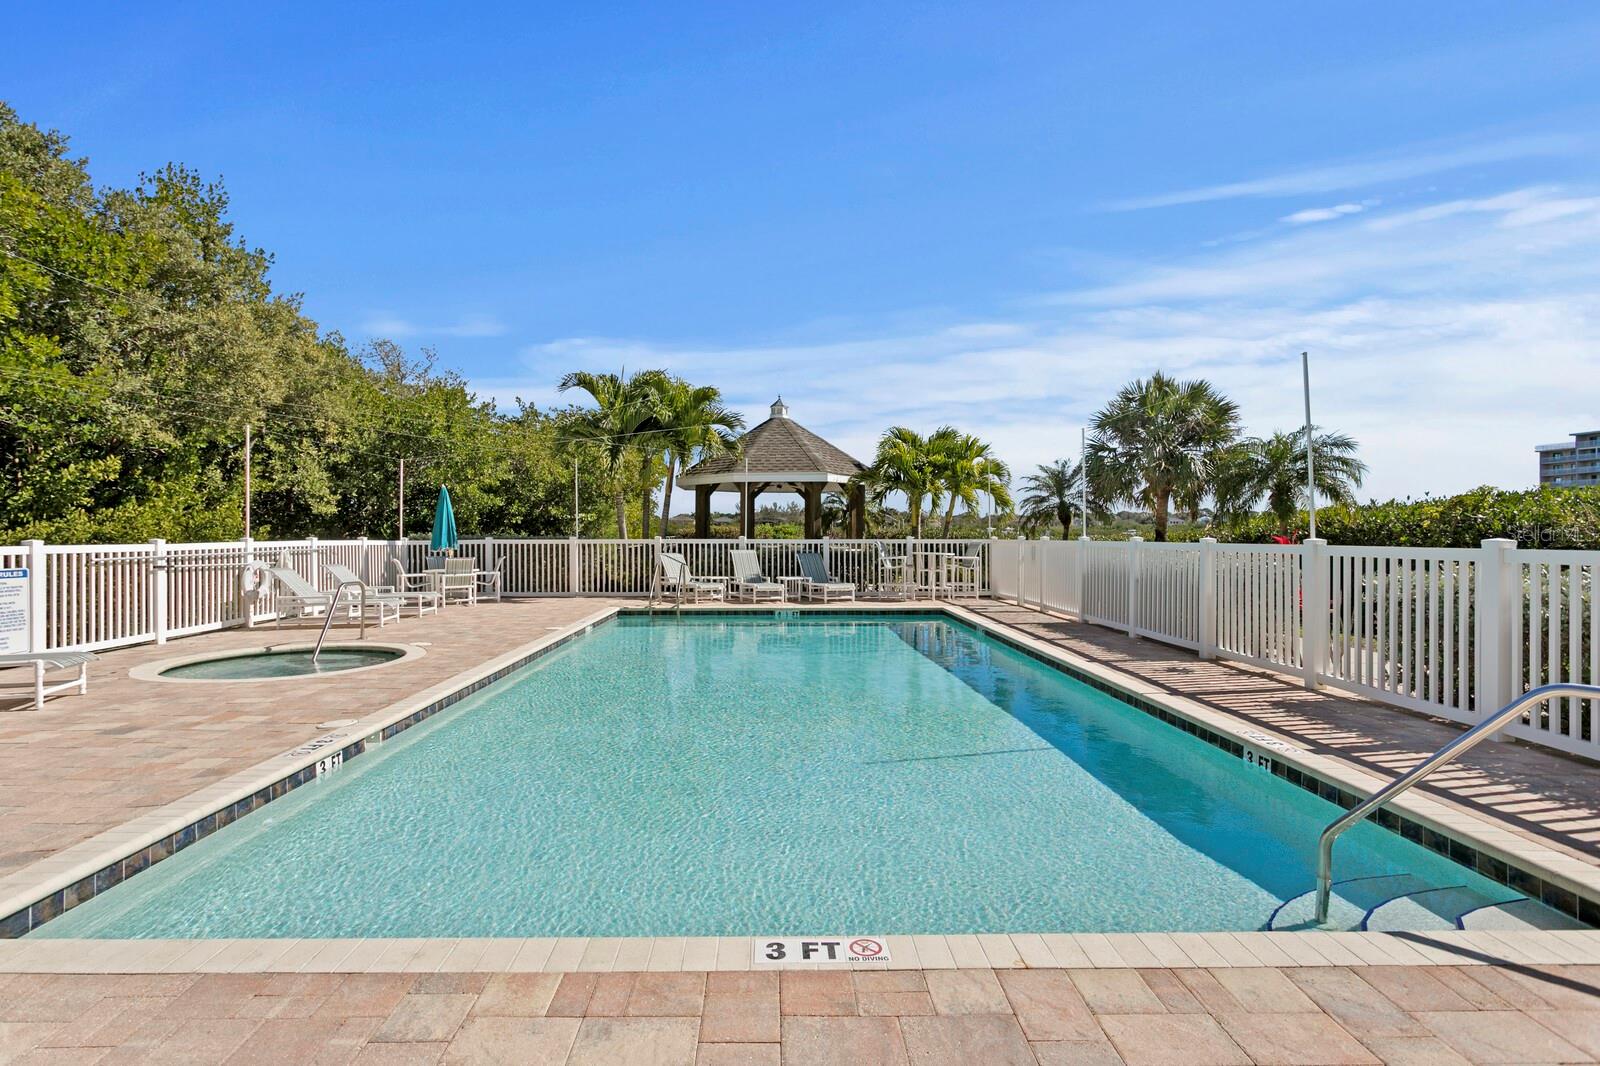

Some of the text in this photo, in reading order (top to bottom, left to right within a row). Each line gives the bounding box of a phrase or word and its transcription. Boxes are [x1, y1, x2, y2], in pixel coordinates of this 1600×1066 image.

[320, 753, 341, 774] 3 FT
[1247, 751, 1270, 770] 3 FT
[765, 942, 840, 960] 3 FT
